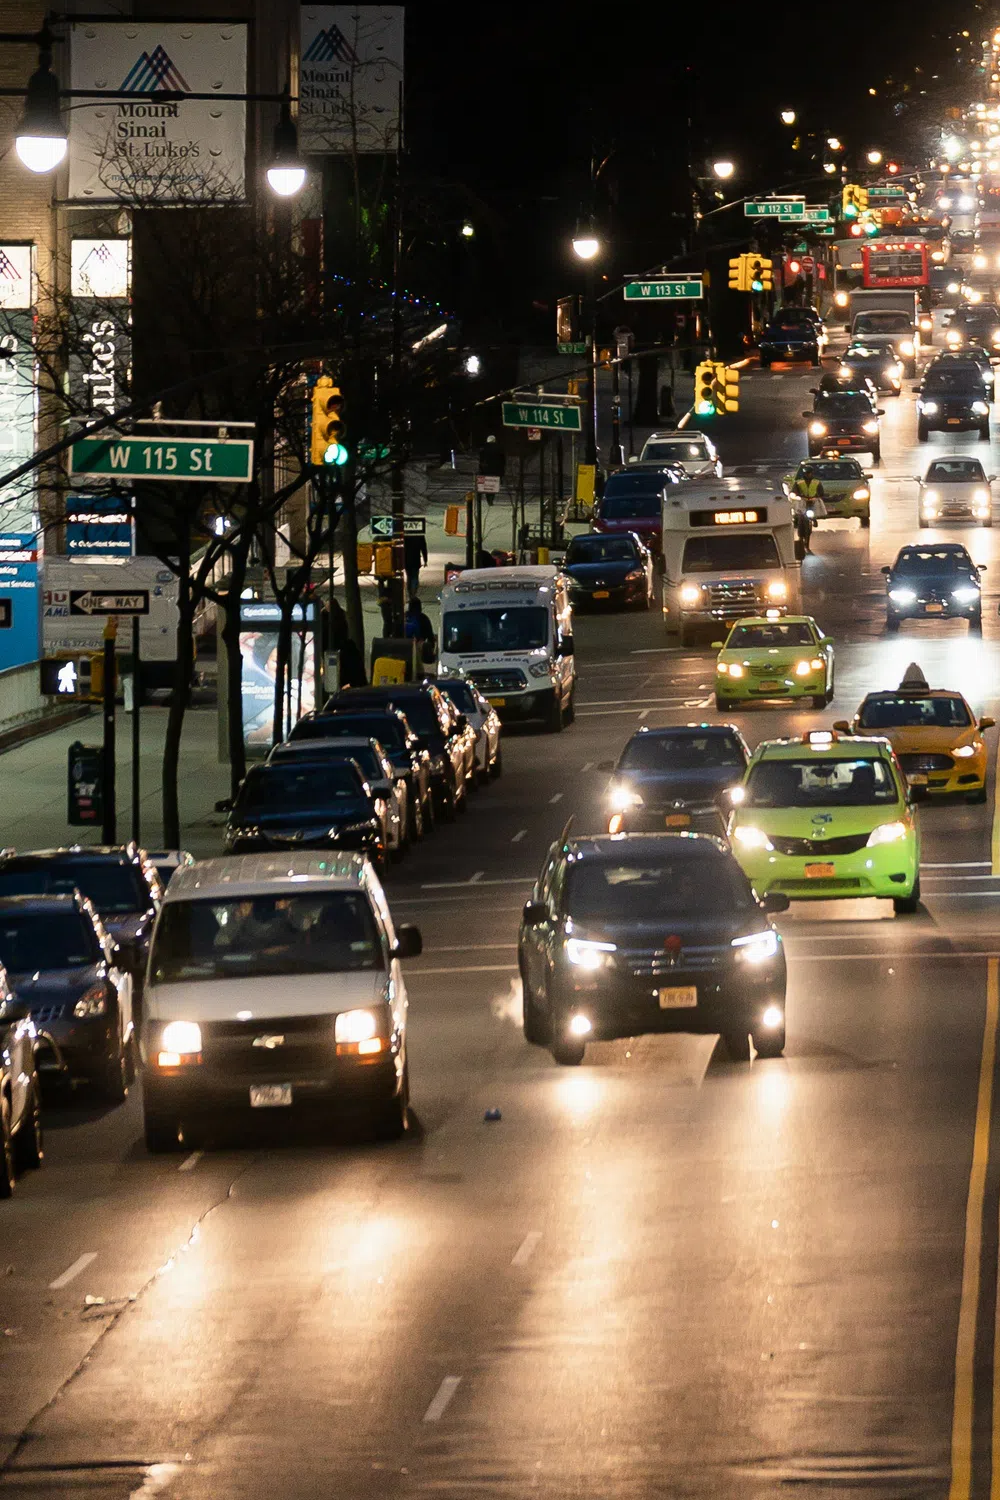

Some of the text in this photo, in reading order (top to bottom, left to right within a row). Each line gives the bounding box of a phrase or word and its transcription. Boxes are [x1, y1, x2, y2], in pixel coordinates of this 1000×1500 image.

[301, 70, 350, 83] Mount
[301, 85, 340, 98] Sinai
[117, 103, 180, 118] Mount
[117, 121, 166, 138] Sinai
[144, 140, 200, 158] Luke's
[757, 203, 793, 214] W 112 St
[640, 284, 687, 296] W 113 St
[518, 408, 565, 425] W 114 St
[109, 446, 213, 472] W 115 St
[81, 597, 140, 608] ONE WAY
